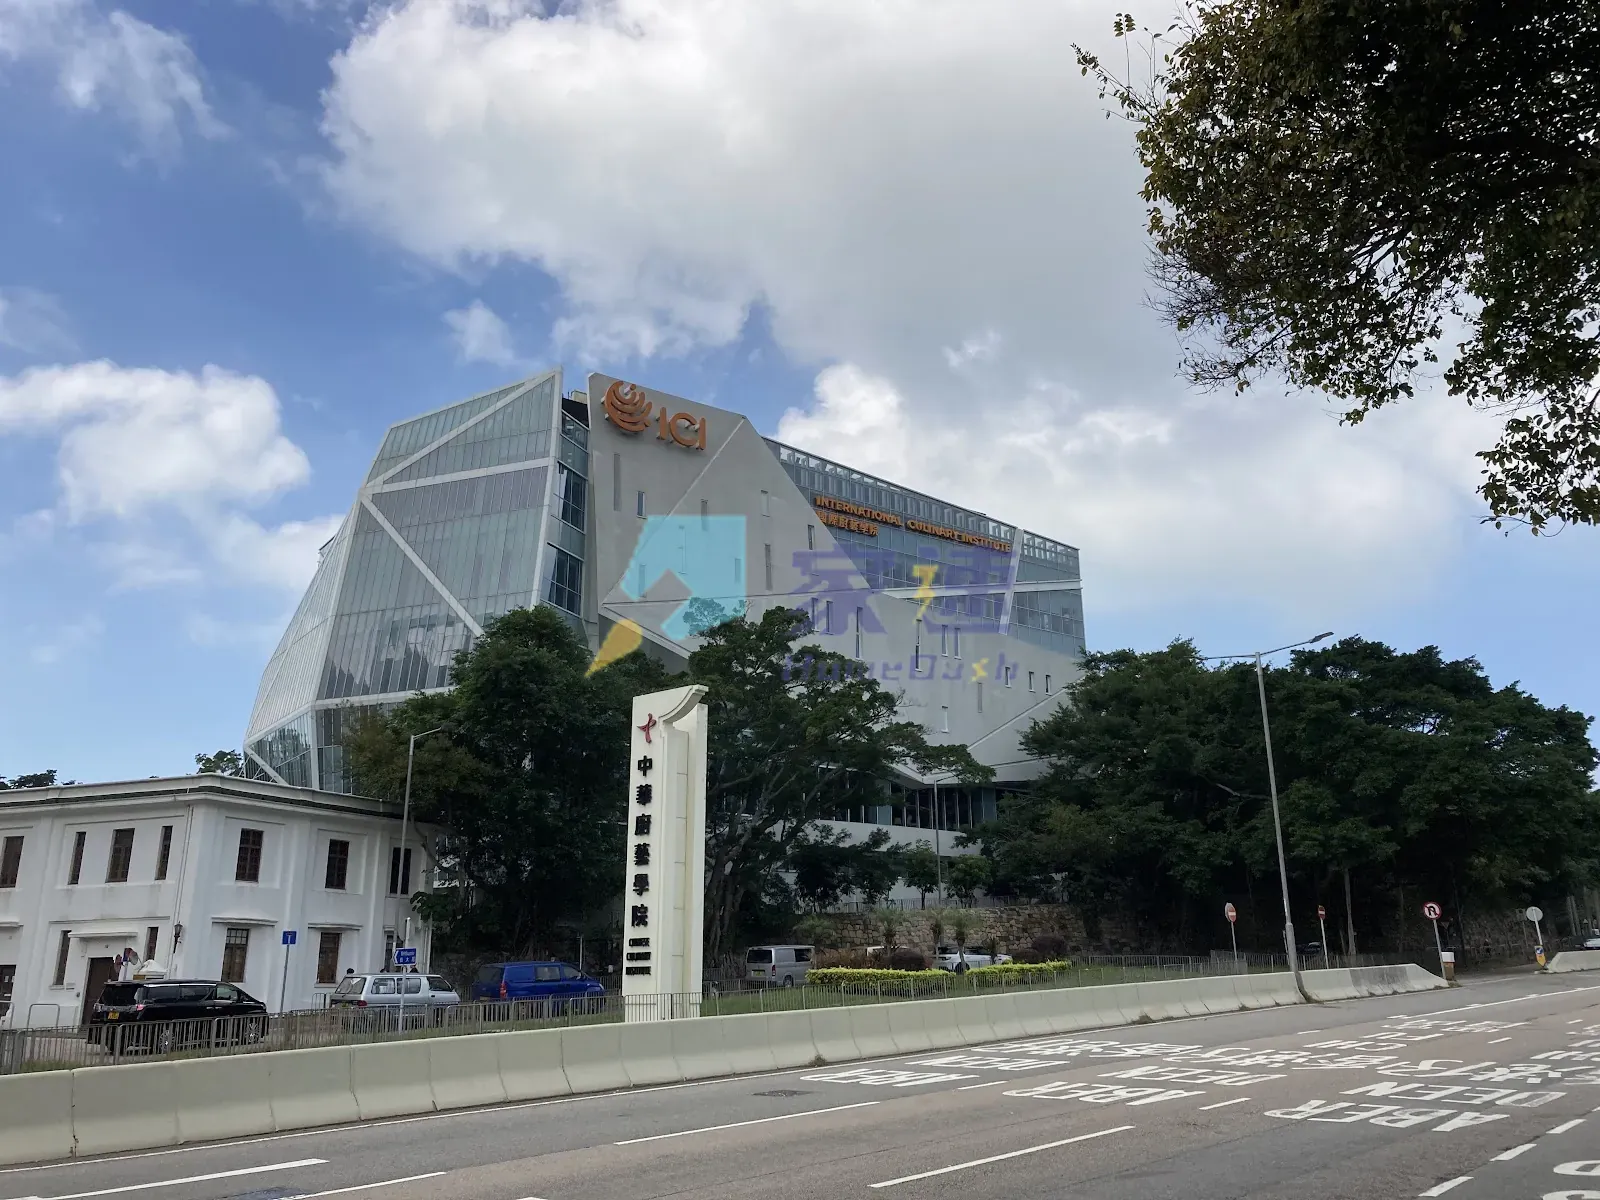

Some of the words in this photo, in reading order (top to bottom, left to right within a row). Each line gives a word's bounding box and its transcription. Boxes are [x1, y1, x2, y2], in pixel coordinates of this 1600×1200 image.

[660, 406, 706, 450] ICI
[815, 495, 904, 528] INTERNATIONAL
[906, 519, 961, 542] CULINARY
[961, 531, 1013, 554] INSTITUTE
[904, 1055, 1071, 1071] DEEN
[1096, 1065, 1289, 1087] DEEN
[799, 1068, 981, 1088] ABER
[1002, 1081, 1207, 1106] ABER
[1338, 1081, 1568, 1108] DEEN
[1263, 1099, 1511, 1132] ABER
